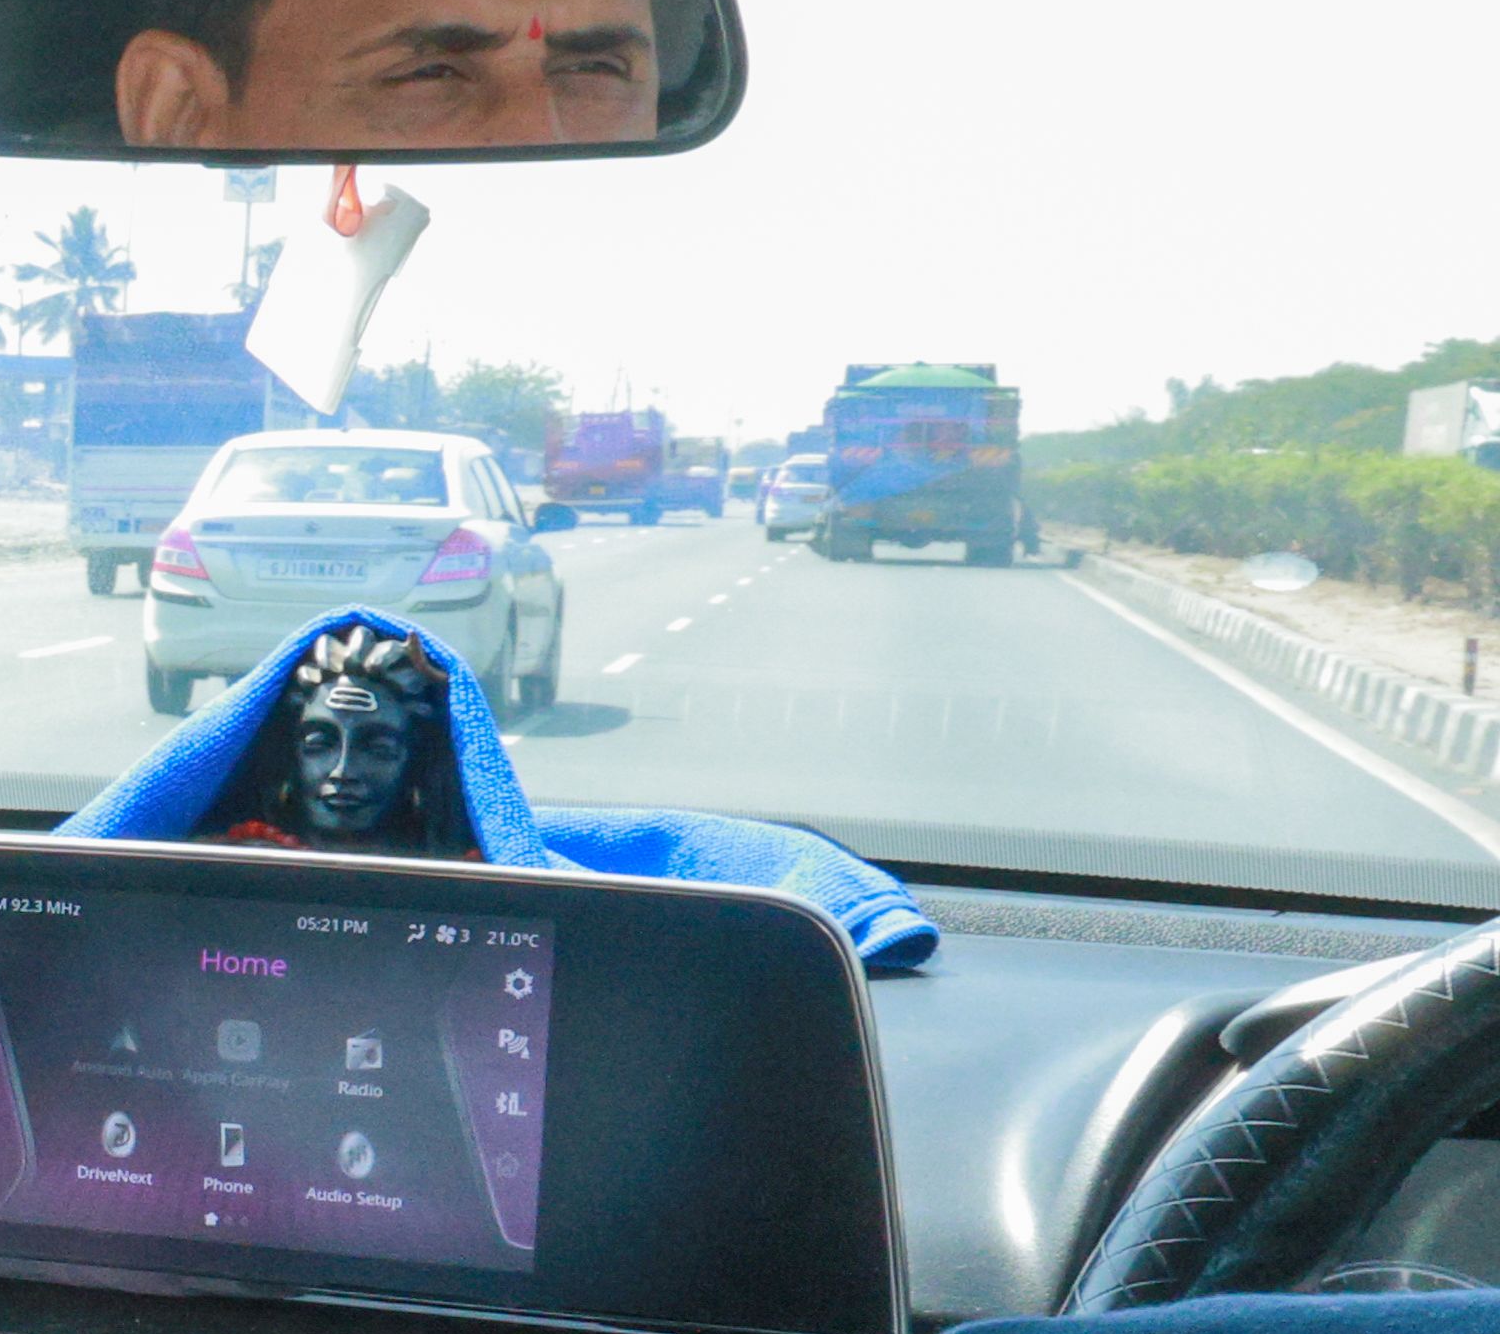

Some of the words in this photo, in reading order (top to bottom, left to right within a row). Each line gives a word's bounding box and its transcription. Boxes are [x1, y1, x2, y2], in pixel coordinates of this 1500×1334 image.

[11, 898, 43, 914] 92.3
[47, 901, 81, 917] MHz
[297, 915, 339, 933] 05:21
[343, 919, 369, 935] PM
[460, 928, 470, 943] 3
[201, 949, 288, 977] Home
[338, 1080, 383, 1098] Radio
[77, 1164, 153, 1186] DriveNext
[203, 1176, 254, 1195] Phone
[305, 1186, 351, 1205] Audio
[356, 1191, 402, 1210] Setup
